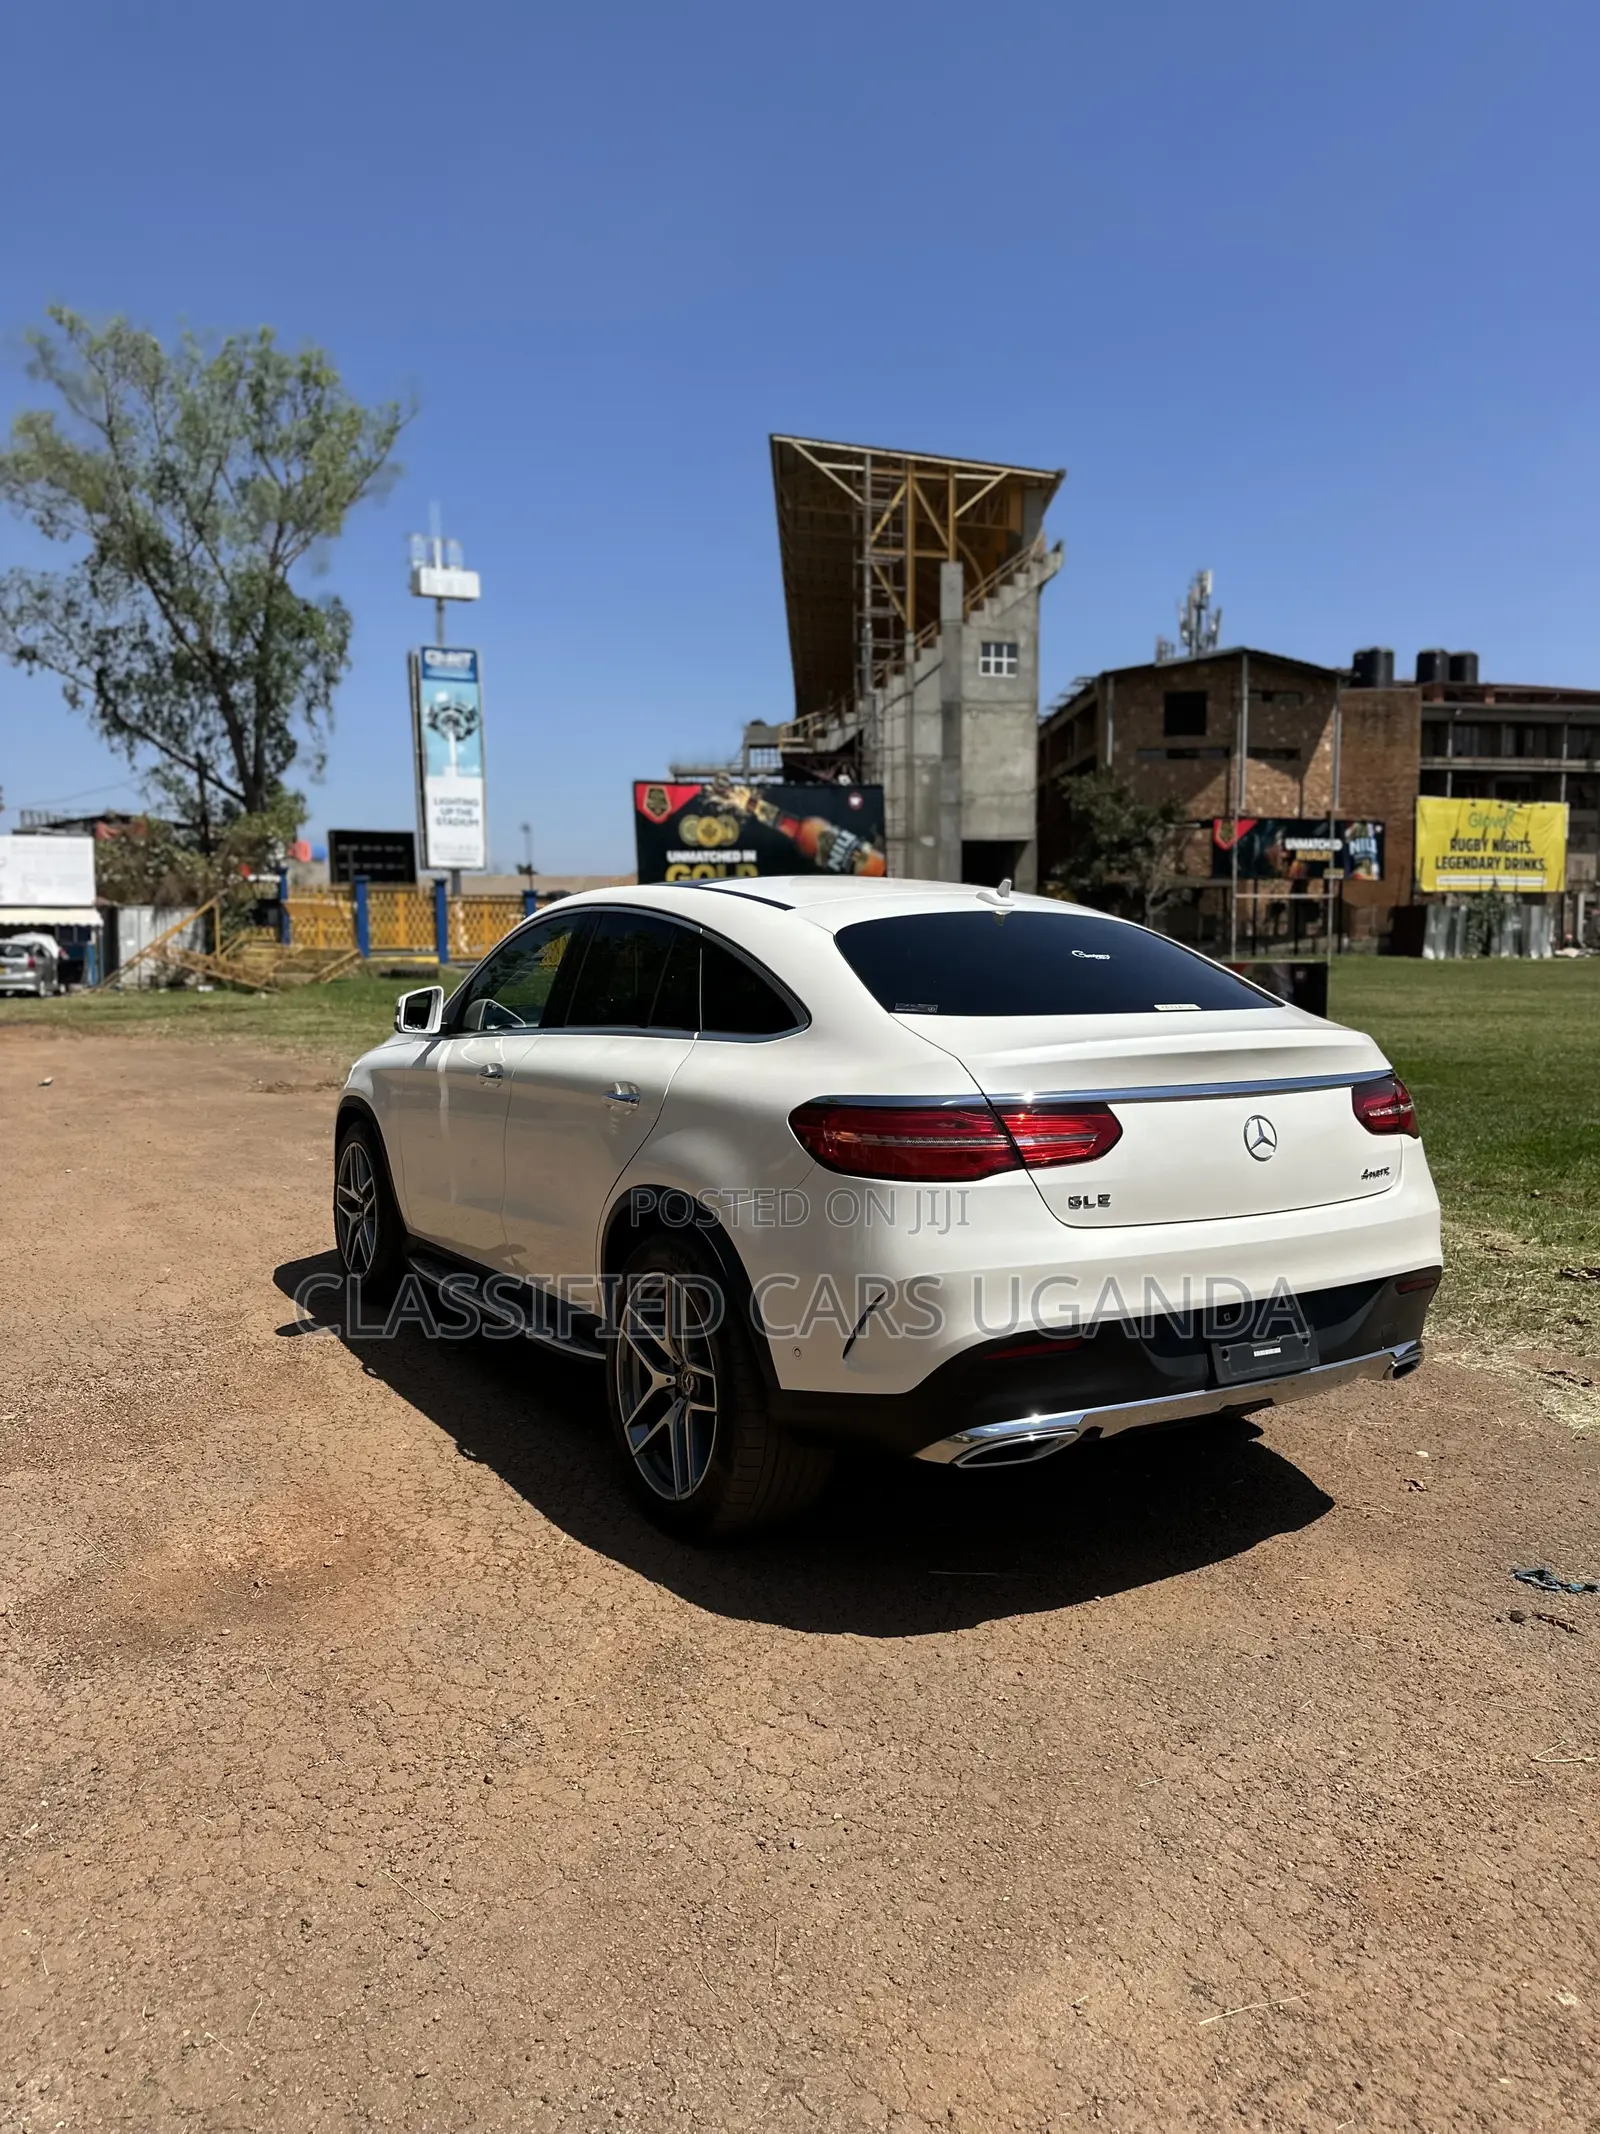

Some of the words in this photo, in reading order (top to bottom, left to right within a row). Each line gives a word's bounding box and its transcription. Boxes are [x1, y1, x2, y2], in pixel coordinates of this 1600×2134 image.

[1450, 838, 1488, 852] RUGBY
[666, 850, 741, 864] UNMATCHED
[742, 850, 757, 862] IN
[1435, 856, 1501, 870] LEGENDARY
[1067, 1193, 1111, 1210] GLE
